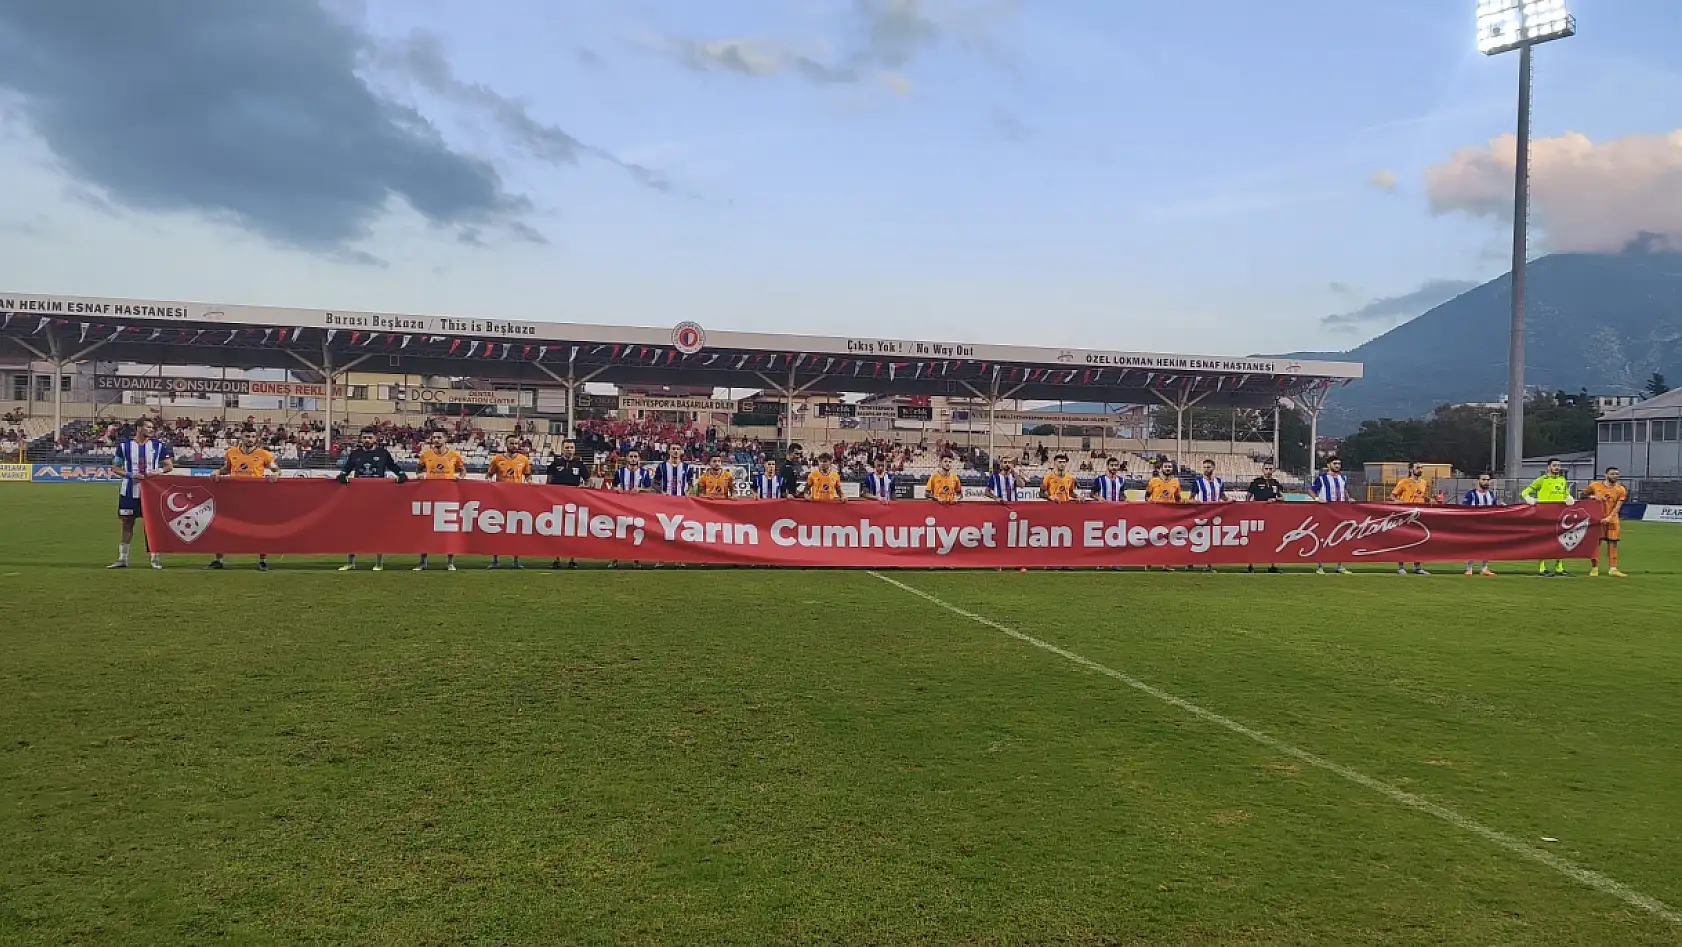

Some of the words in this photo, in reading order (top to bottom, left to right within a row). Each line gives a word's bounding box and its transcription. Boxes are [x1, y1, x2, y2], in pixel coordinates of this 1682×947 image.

[19, 299, 62, 312] HEKİM
[67, 302, 110, 314] ESNAF
[114, 304, 188, 318] HASTANESİ
[325, 312, 367, 326] Burası
[372, 315, 424, 330] Beşkaza
[440, 318, 467, 332] This
[471, 319, 481, 332] is
[486, 321, 536, 336] Beşkaza
[847, 340, 874, 354] Çıkış
[877, 340, 896, 353] Yok
[916, 343, 929, 354] No
[933, 344, 953, 356] Way
[956, 344, 973, 356] Out
[1086, 354, 1111, 364] ÖZEL
[1113, 356, 1153, 366] LOKMAN
[1156, 356, 1187, 368] HEKİM
[1190, 358, 1220, 369] ESNAF
[1223, 360, 1275, 372] HASTANESİ
[99, 376, 162, 390] SEVDAMIZ
[295, 384, 343, 397] REKLM
[411, 388, 446, 402] DOC
[411, 500, 646, 546] "Efendiler;
[656, 512, 759, 545] Yarın
[770, 517, 997, 555] Cumhuriyet
[1006, 511, 1073, 547] İlan
[1083, 516, 1266, 552] Edeceğiz!"
